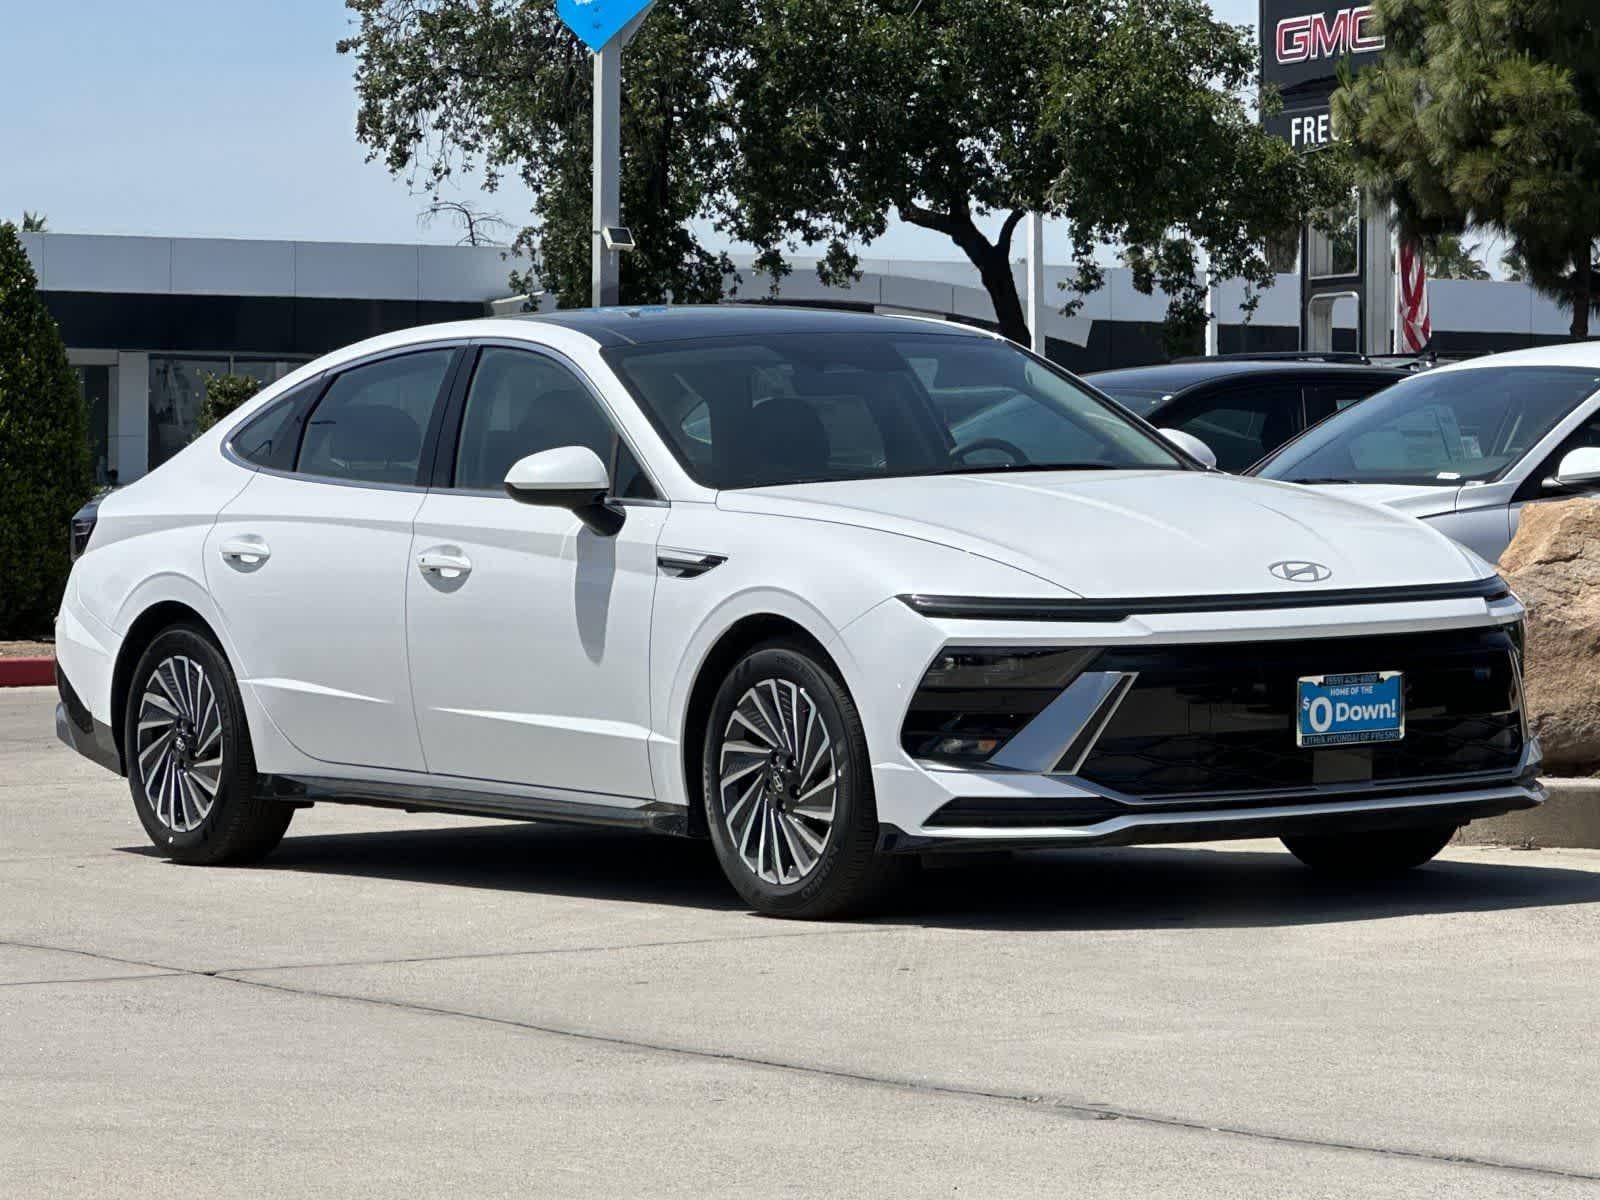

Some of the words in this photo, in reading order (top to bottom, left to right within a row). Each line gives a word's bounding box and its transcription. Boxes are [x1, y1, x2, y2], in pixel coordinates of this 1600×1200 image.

[1276, 5, 1386, 65] GMC
[1291, 114, 1341, 147] FRE
[1330, 687, 1349, 697] HOME
[1350, 687, 1360, 695] OF
[1361, 686, 1374, 695] THE
[1335, 698, 1397, 722] Down!
[1328, 733, 1359, 744] HYUNDAI
[1360, 732, 1370, 743] OF
